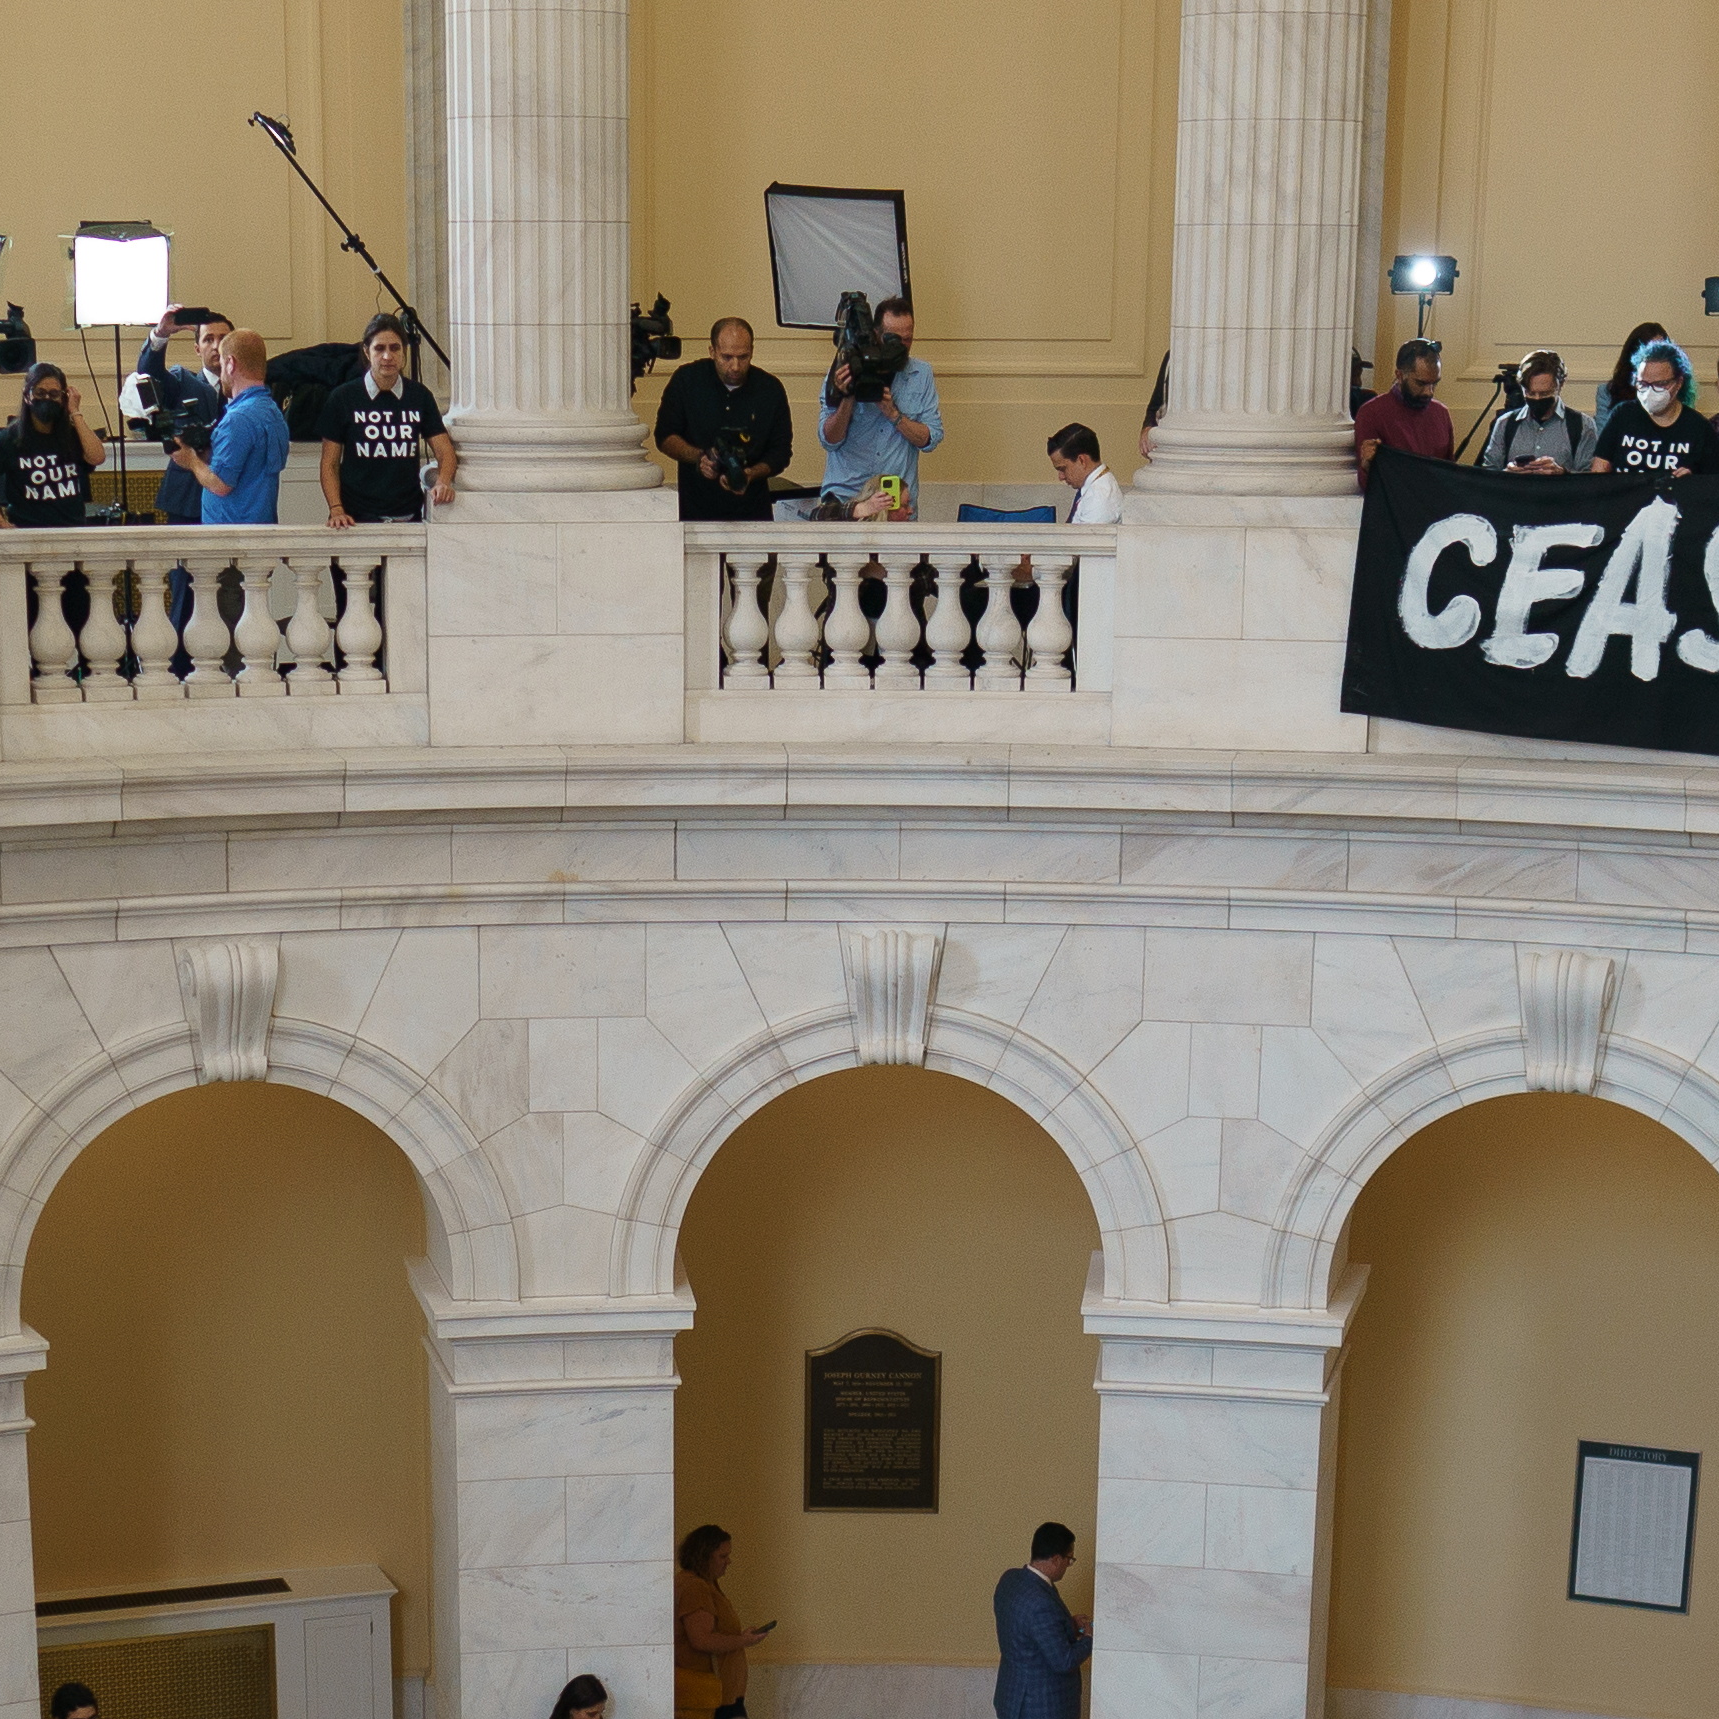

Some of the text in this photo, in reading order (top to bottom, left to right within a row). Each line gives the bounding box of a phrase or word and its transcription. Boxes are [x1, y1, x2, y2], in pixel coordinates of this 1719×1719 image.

[354, 410, 420, 423] NOT IN
[365, 425, 412, 440] OUR
[357, 442, 416, 458] NAME
[1622, 436, 1690, 453] NOT IN
[20, 456, 57, 469] NOT
[1627, 451, 1679, 469] OUR
[31, 464, 77, 484] OUR
[1609, 1447, 1668, 1462] DIRECTORY
